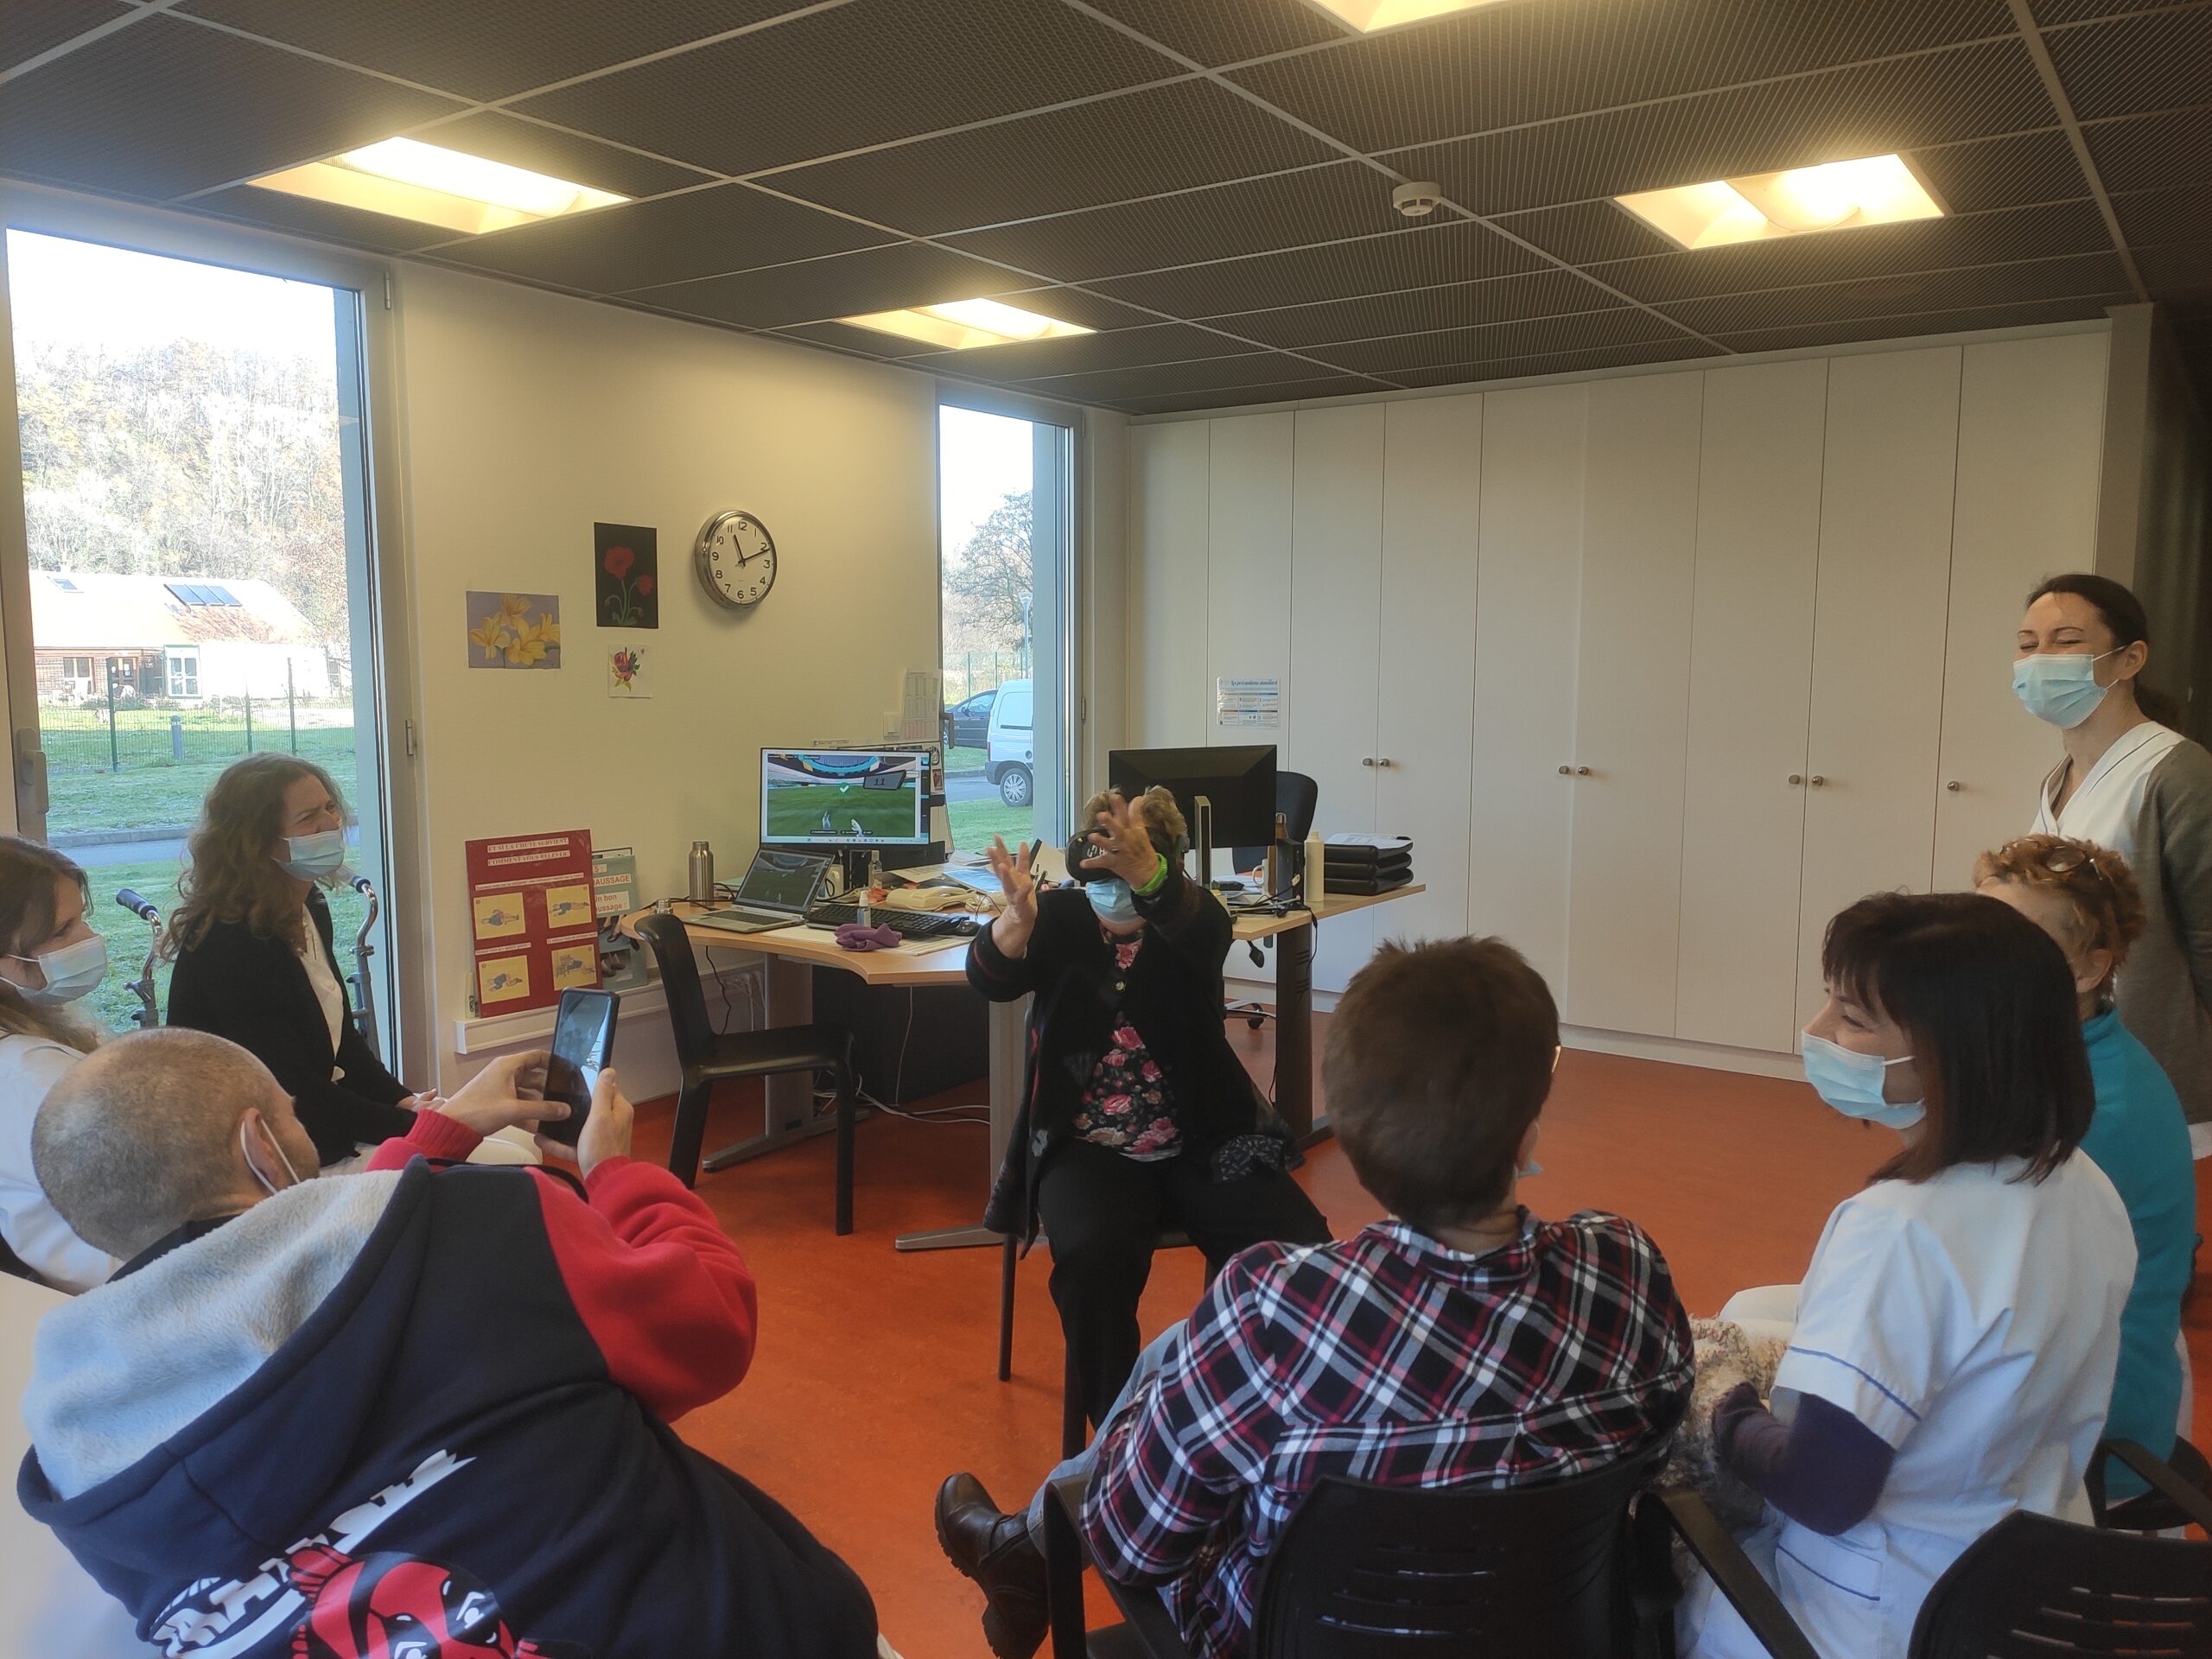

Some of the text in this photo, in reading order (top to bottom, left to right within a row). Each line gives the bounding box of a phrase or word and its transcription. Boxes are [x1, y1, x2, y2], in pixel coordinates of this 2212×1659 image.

[727, 524, 733, 533] 11
[739, 521, 747, 531] 12
[717, 536, 724, 545] 10
[760, 542, 768, 551] 2
[712, 552, 719, 561] 9
[763, 560, 770, 569] 3
[715, 570, 723, 579] 8
[759, 576, 766, 585] 4
[725, 584, 731, 593] 7
[750, 587, 757, 596] 5
[737, 590, 744, 599] 6
